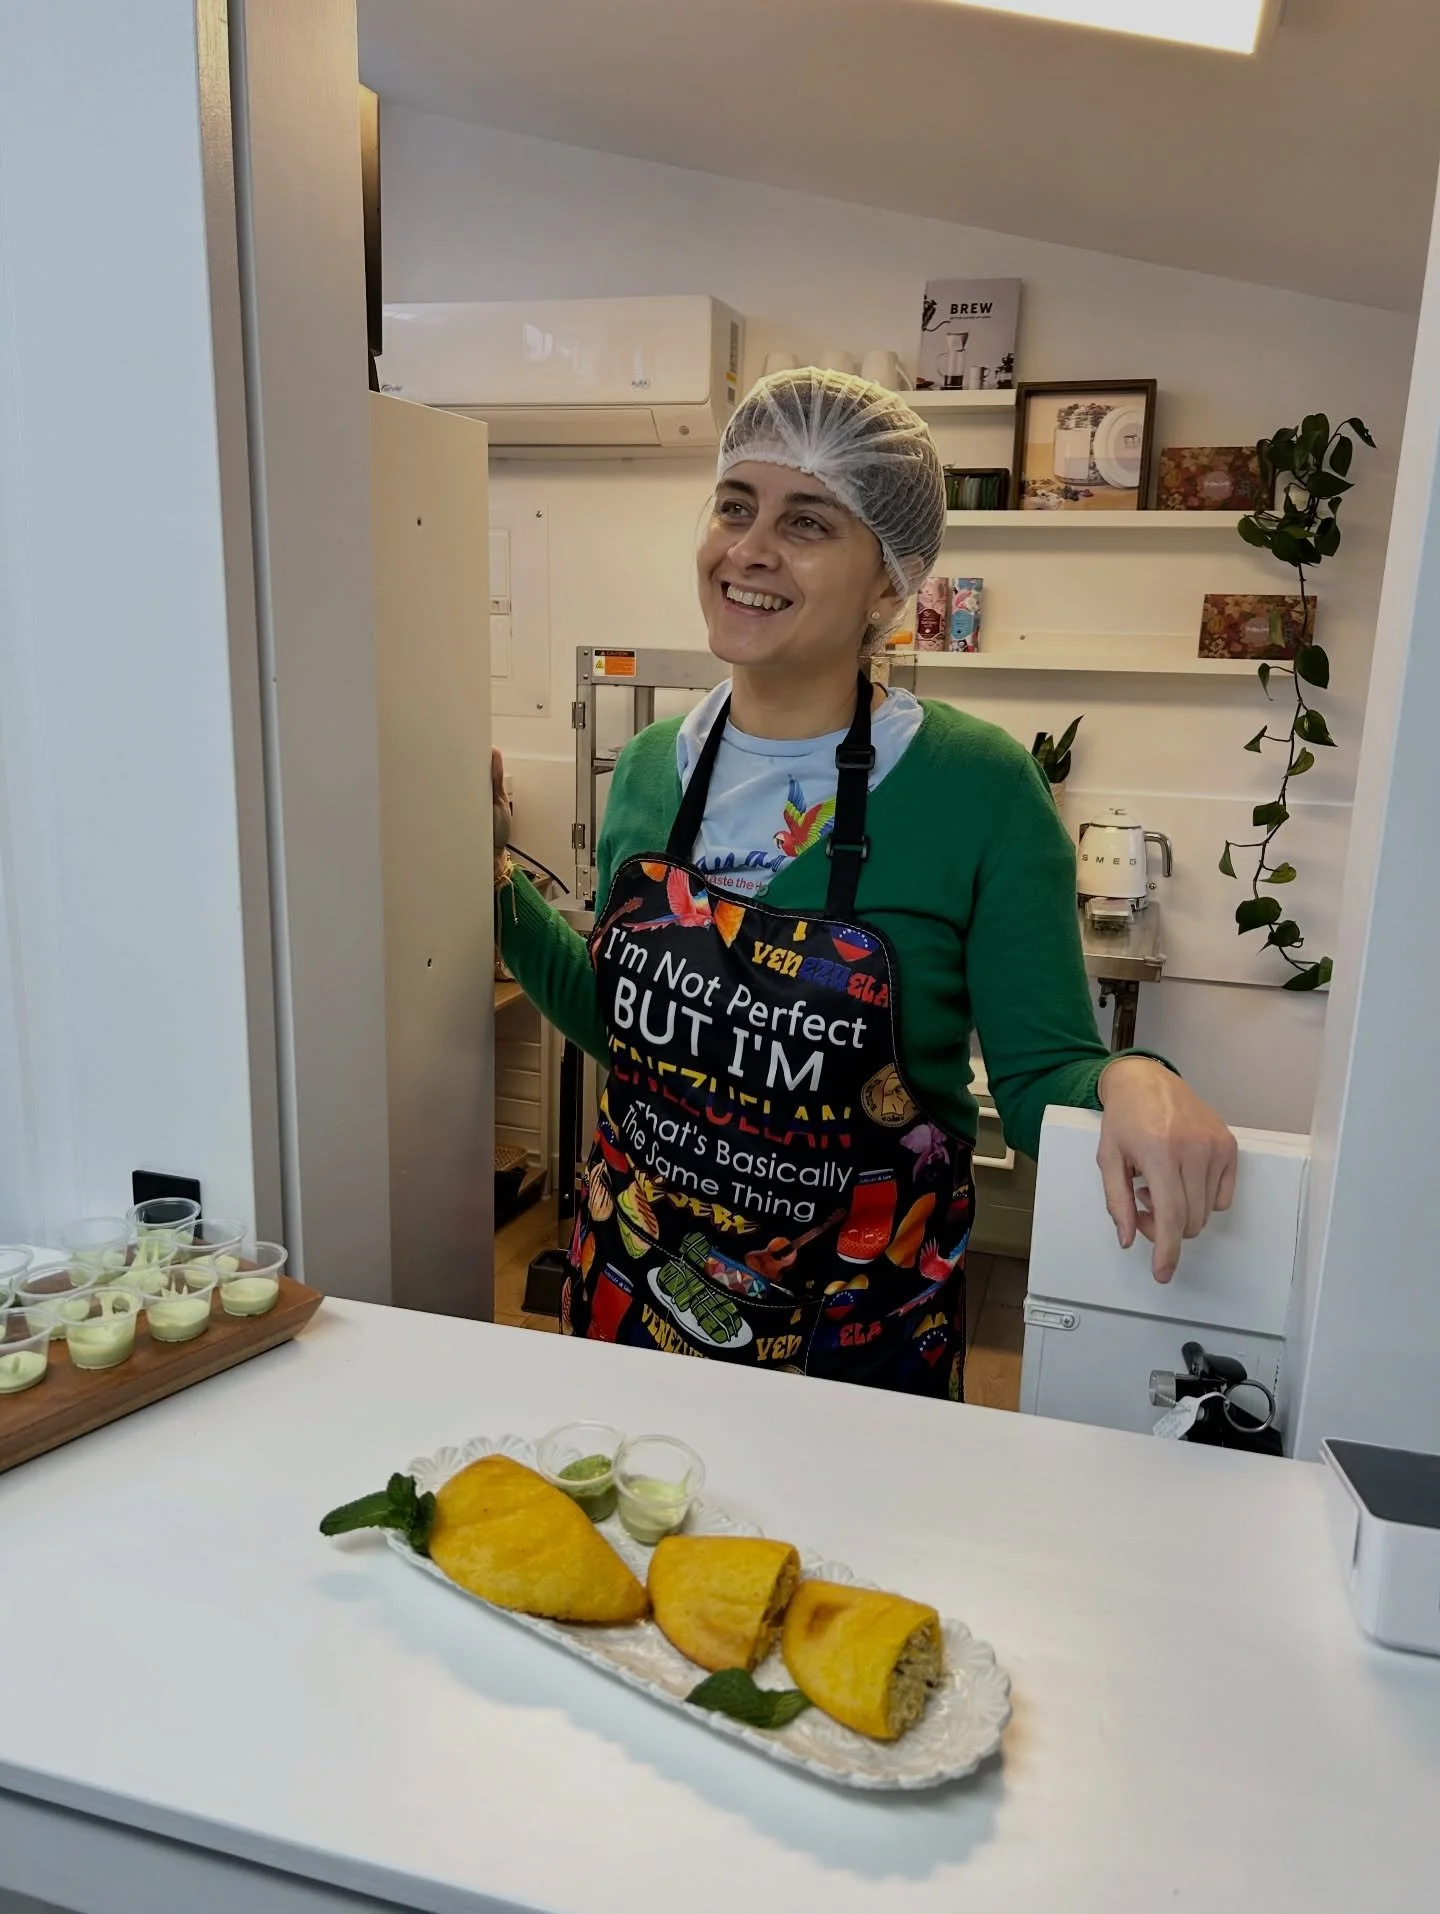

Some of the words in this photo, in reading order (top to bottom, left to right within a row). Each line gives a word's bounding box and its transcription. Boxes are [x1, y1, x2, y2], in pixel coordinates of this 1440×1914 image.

[950, 302, 993, 315] BREW
[735, 877, 754, 890] the
[1082, 853, 1137, 866] SMEG
[604, 927, 649, 974] I'm
[653, 951, 722, 1007] Not
[726, 983, 867, 1049] Perfect
[614, 976, 713, 1057] BUT
[728, 1026, 824, 1092] I'M
[622, 1104, 645, 1150] The
[646, 1141, 720, 1195] Same
[731, 1181, 815, 1223] Thing
[636, 1100, 707, 1155] That's
[716, 1139, 853, 1192] Basically
